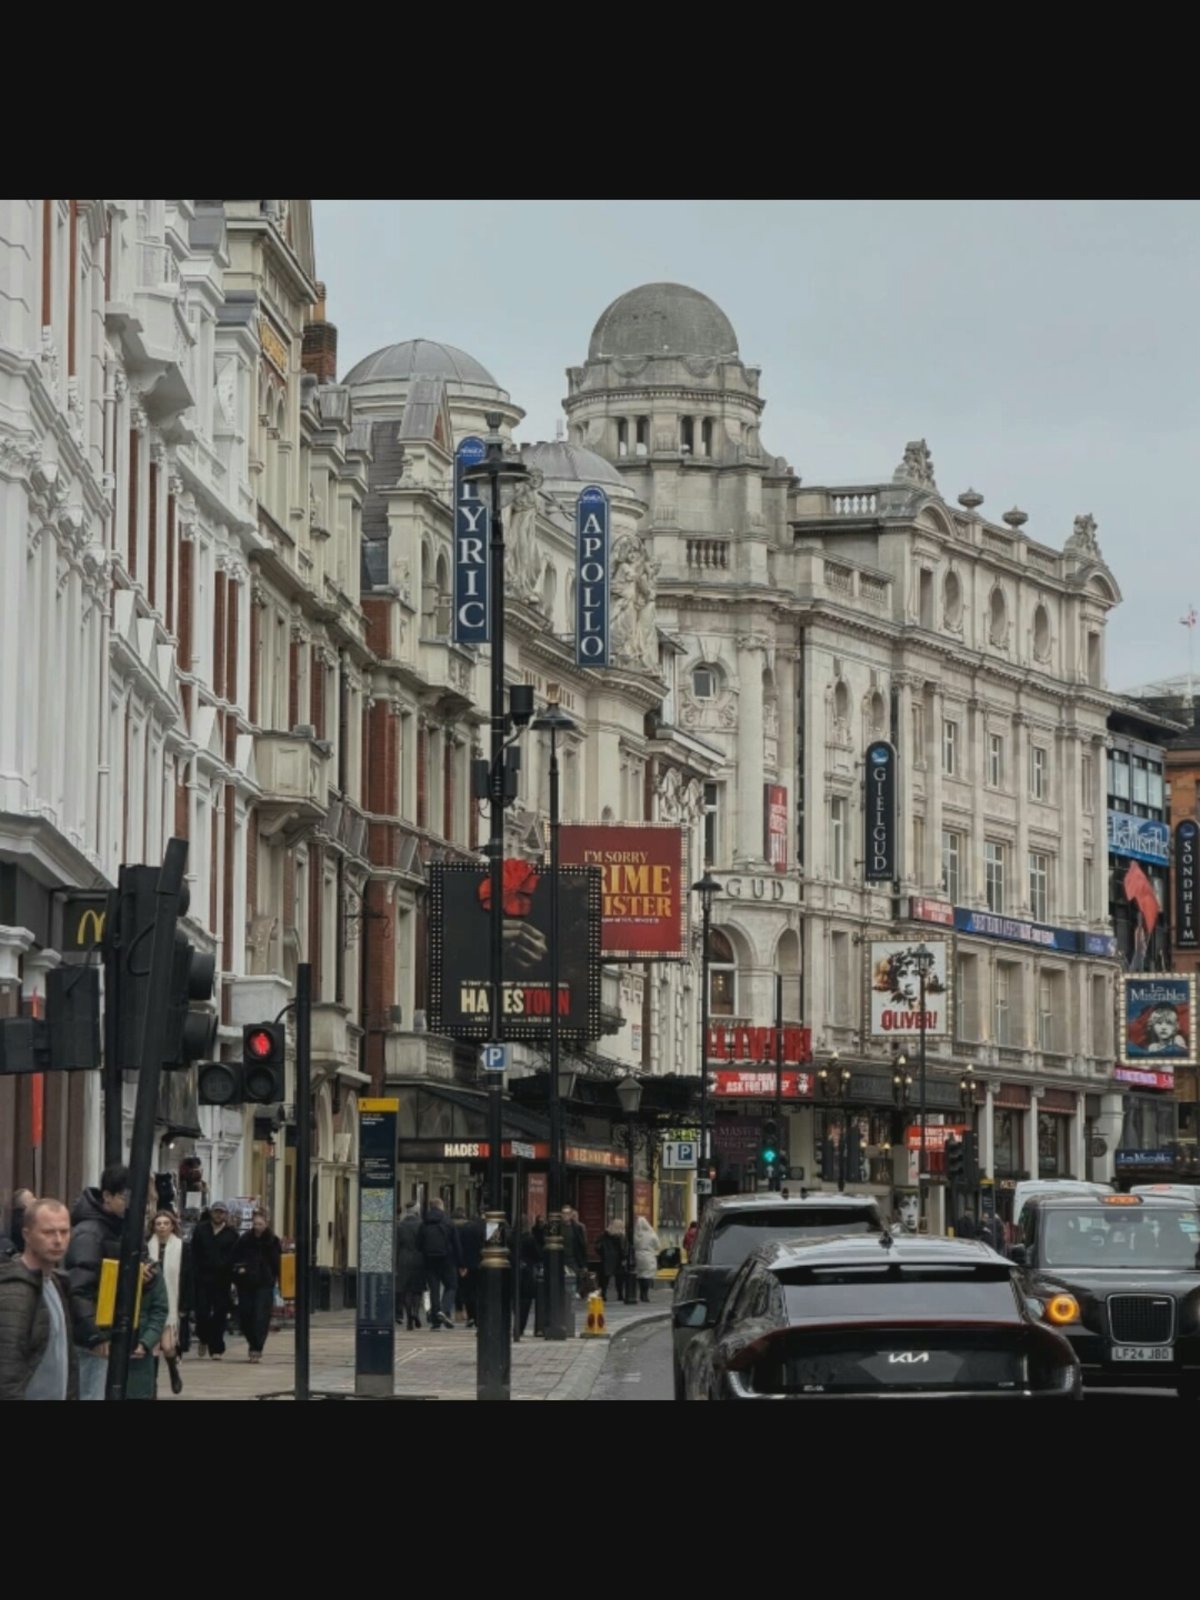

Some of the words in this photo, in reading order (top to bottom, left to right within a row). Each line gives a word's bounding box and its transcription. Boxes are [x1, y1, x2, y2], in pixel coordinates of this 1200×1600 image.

[580, 513, 604, 657] APOLLO
[873, 767, 887, 870] GIELGUD
[584, 851, 602, 863] I'M
[604, 850, 648, 863] SORRY
[600, 864, 673, 894] RIME
[1183, 840, 1194, 940] SONDHEIM
[603, 896, 672, 917] ISTER
[461, 988, 571, 1015] HAESTOWN
[881, 1009, 938, 1031] OLIVER!
[489, 1047, 502, 1066] P
[681, 1145, 692, 1160] P
